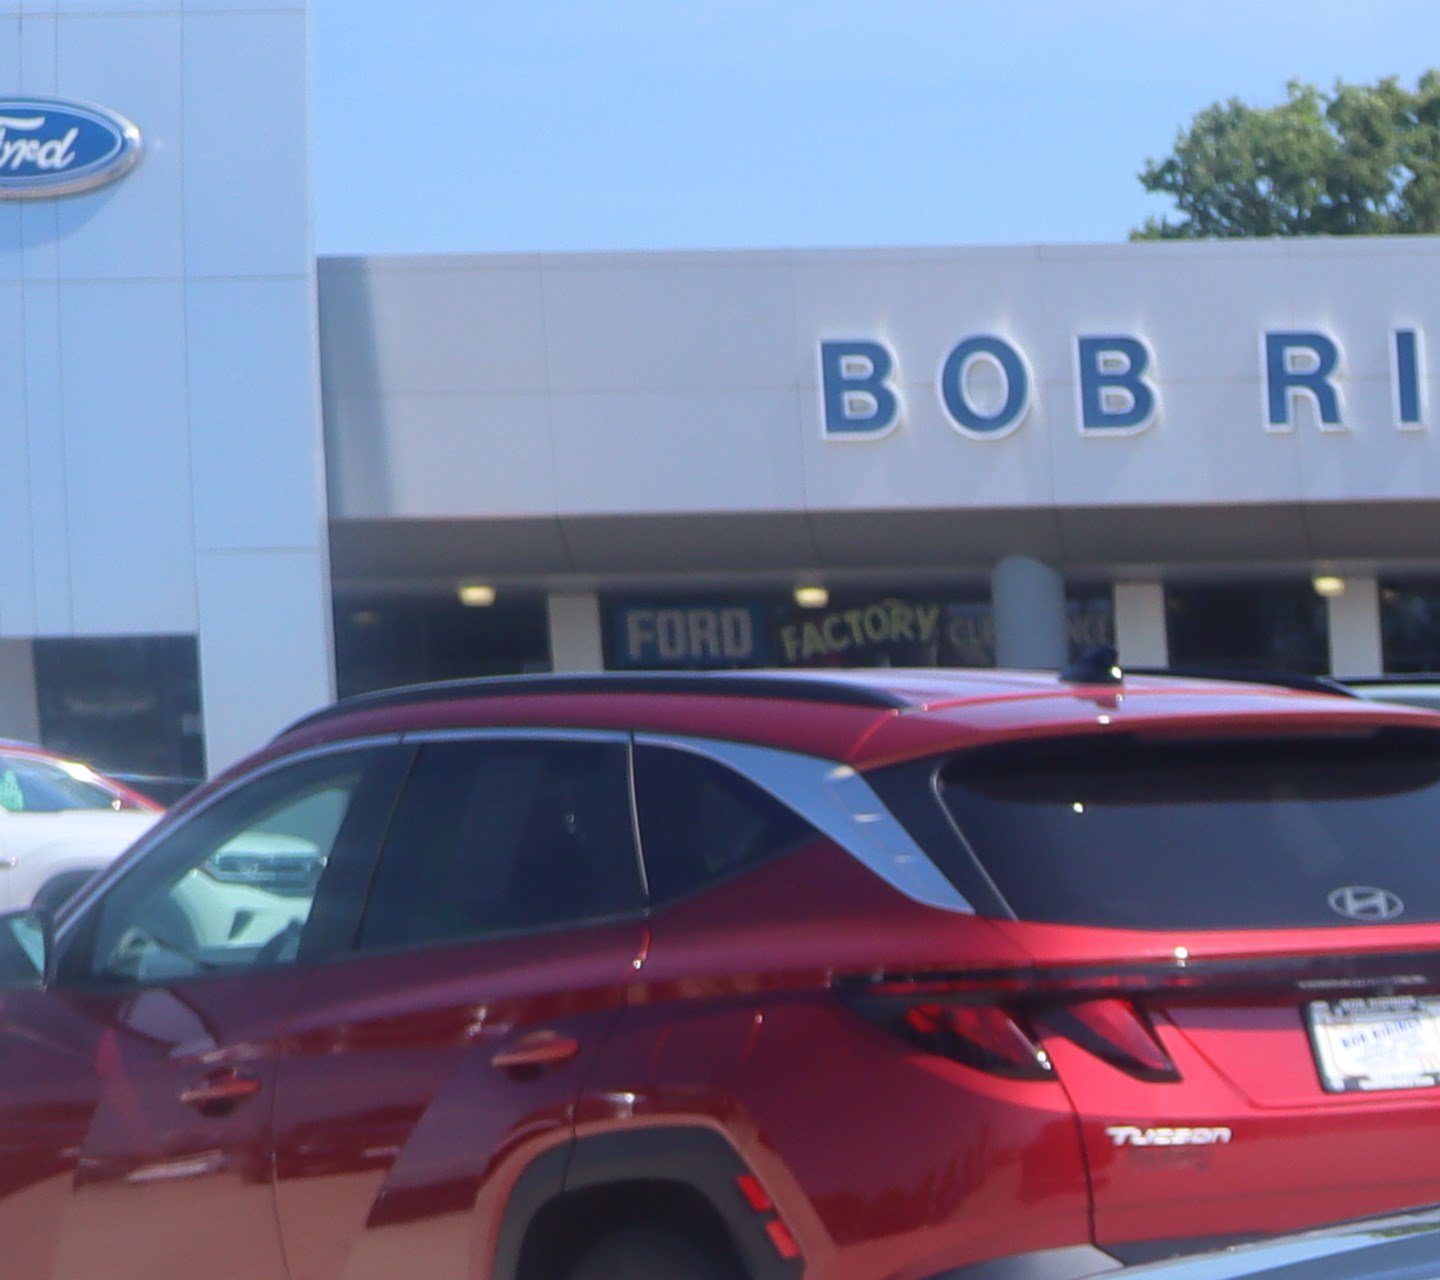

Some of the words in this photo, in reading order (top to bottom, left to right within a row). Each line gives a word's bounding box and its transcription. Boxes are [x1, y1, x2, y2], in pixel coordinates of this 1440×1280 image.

[822, 333, 1153, 432] BOB
[626, 608, 753, 661] FORD
[781, 602, 940, 662] FACTORY
